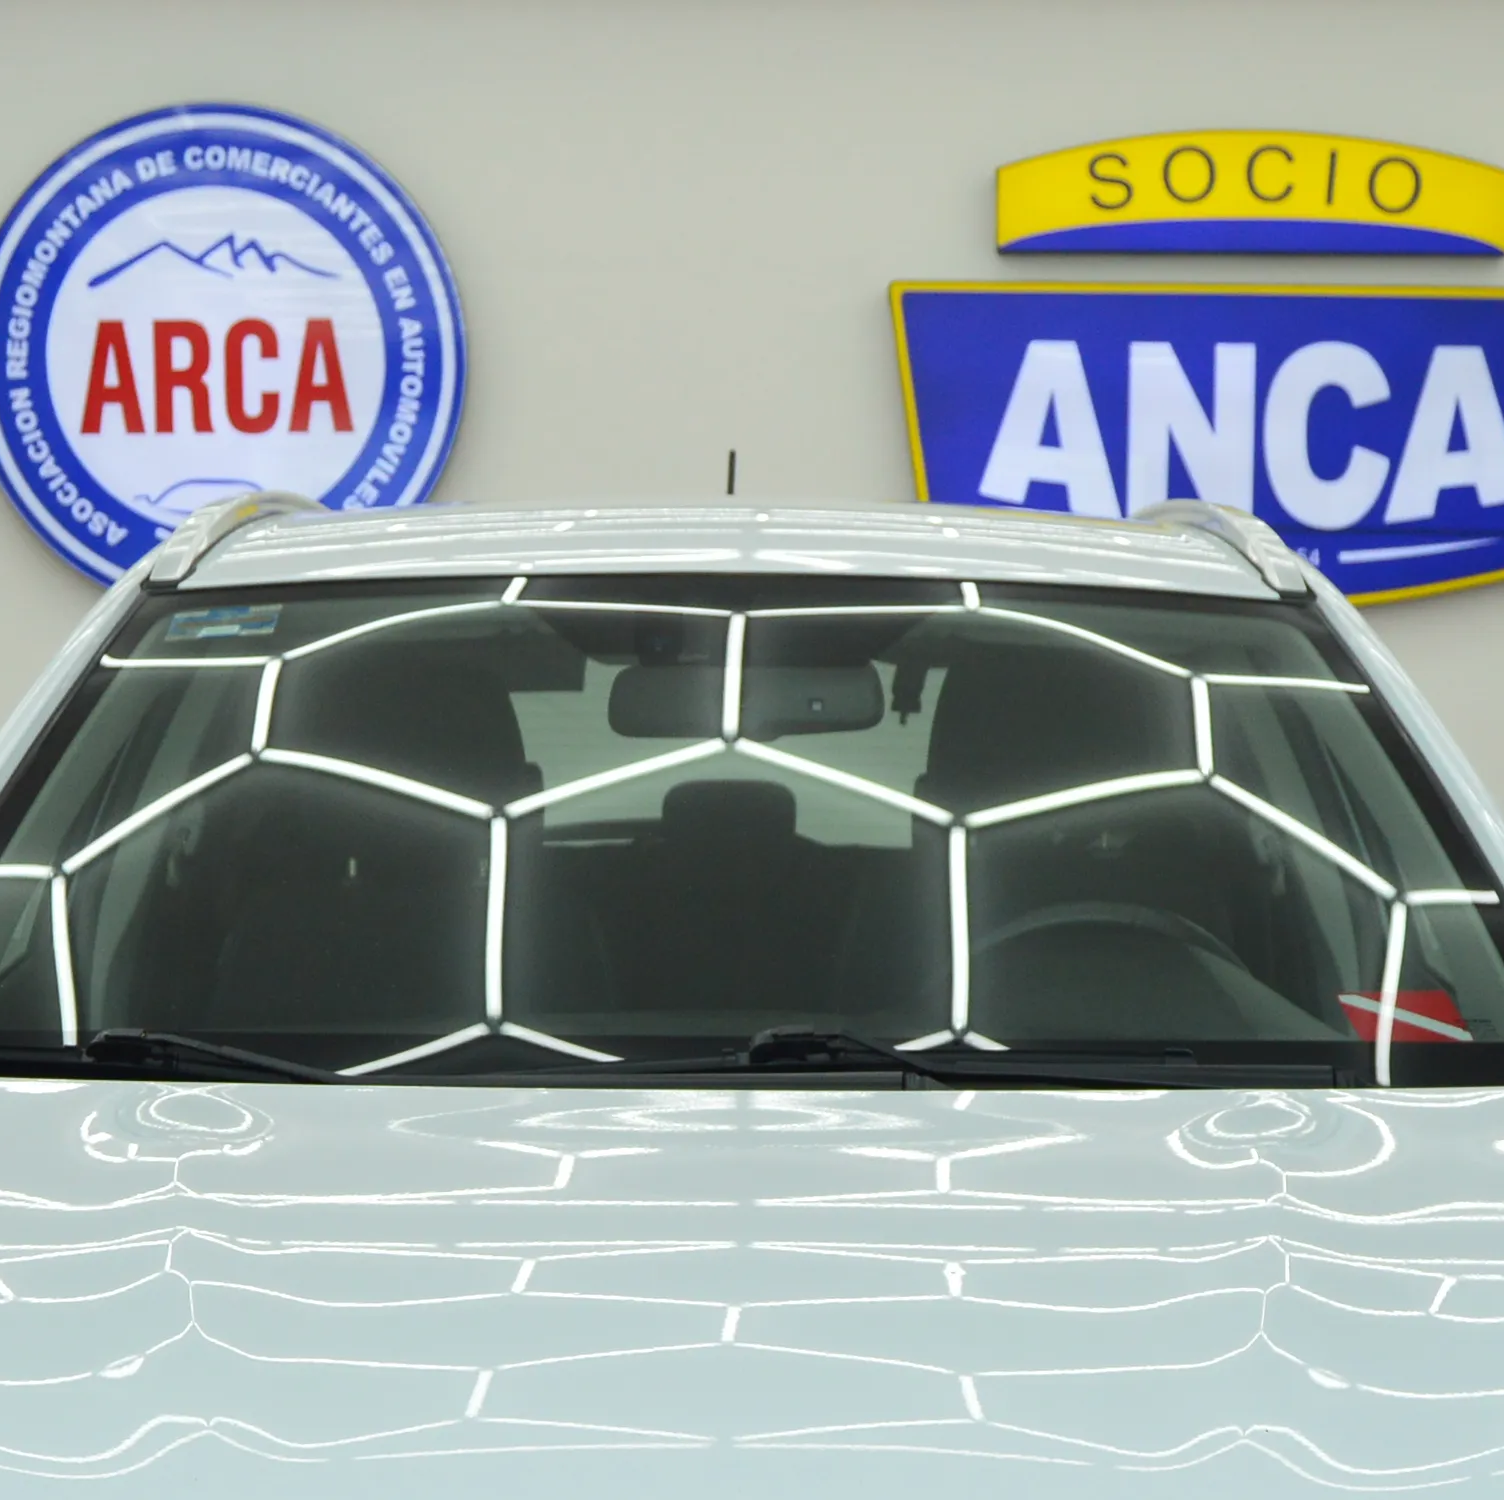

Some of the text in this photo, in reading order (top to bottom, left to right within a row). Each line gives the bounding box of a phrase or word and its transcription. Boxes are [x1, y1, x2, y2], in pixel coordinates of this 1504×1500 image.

[136, 150, 178, 183] DE
[184, 144, 395, 267] COMERCIANTES
[1088, 146, 1422, 213] SOCIO
[5, 168, 134, 380] REGIOMONTANA
[383, 265, 416, 312] EN
[81, 317, 354, 435] ARCA
[9, 386, 129, 547] ASOCIACION
